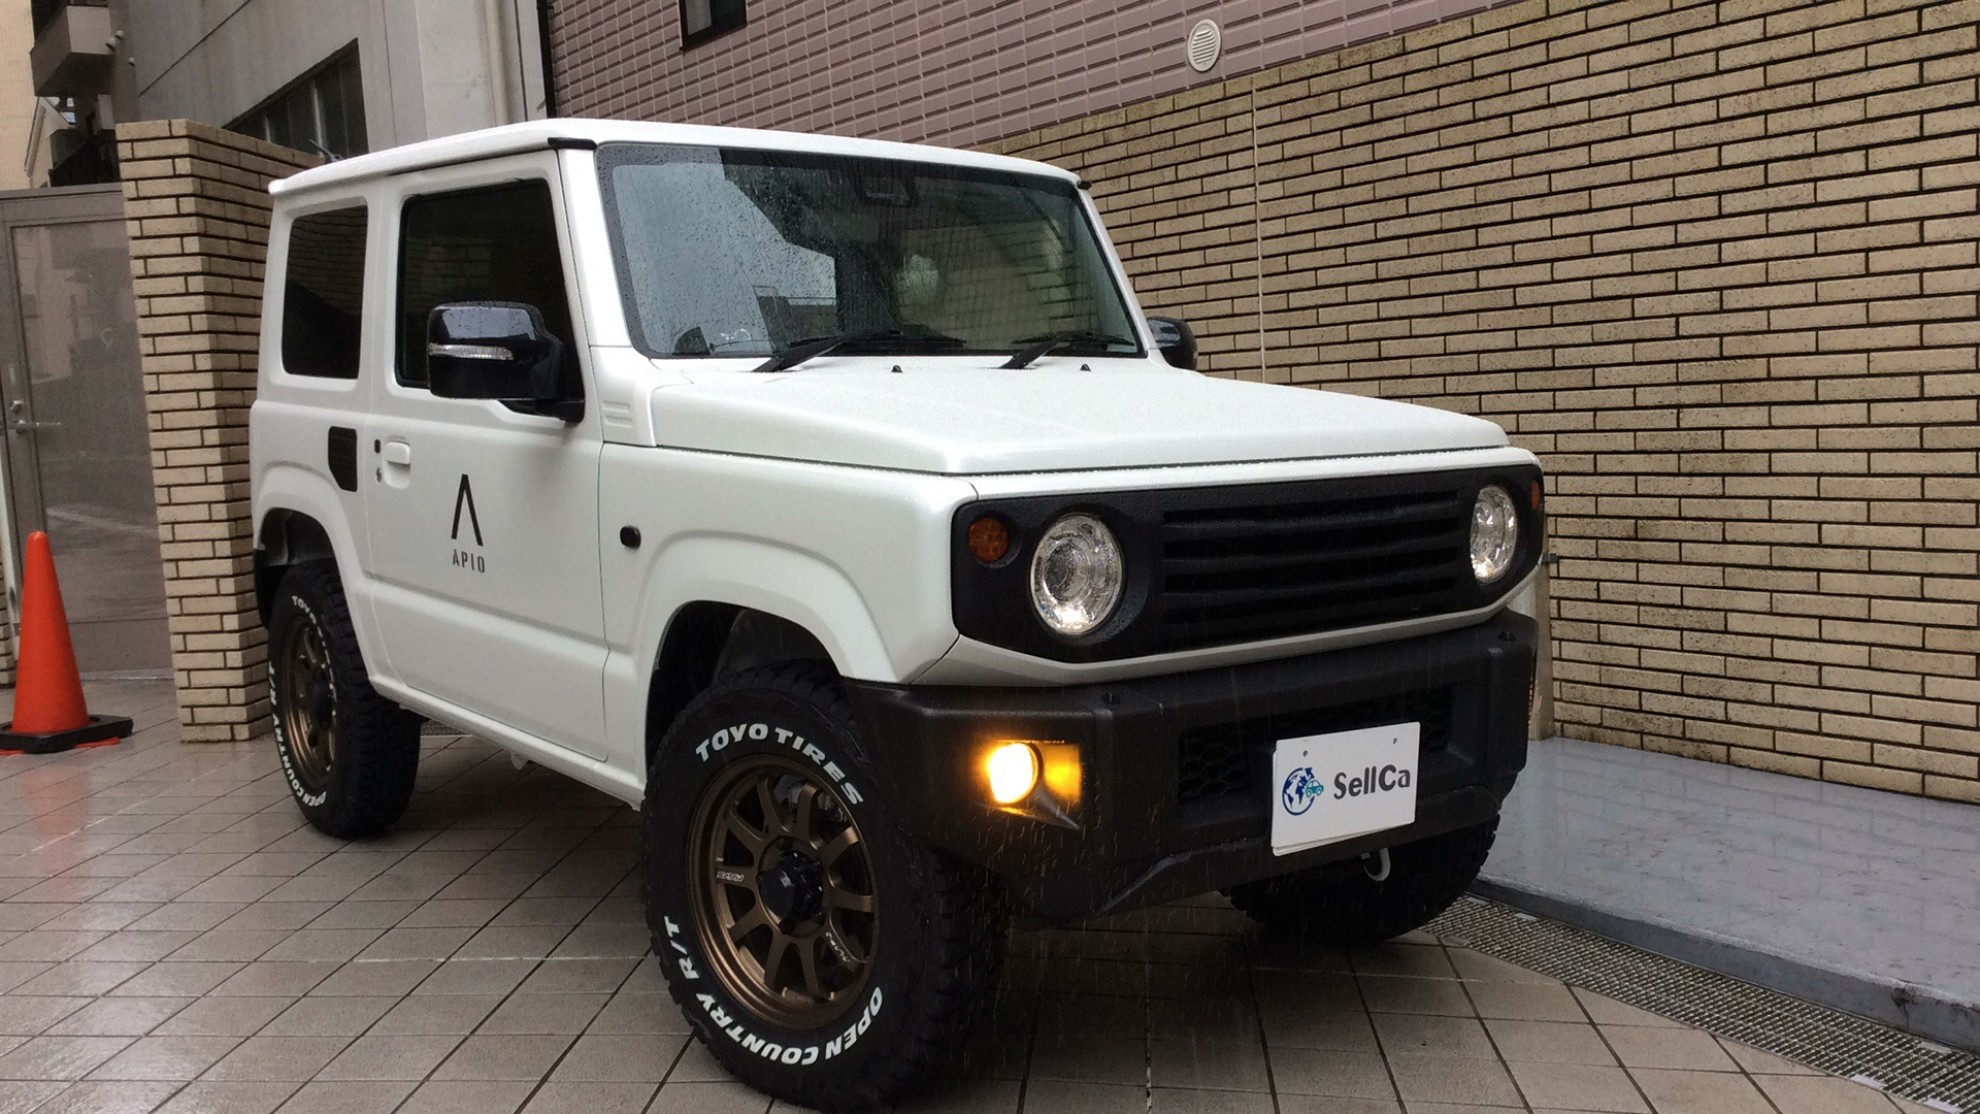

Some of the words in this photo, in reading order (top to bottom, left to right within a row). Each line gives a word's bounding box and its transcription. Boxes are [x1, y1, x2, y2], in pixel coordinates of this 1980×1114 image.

[452, 548, 486, 574] APIO
[695, 722, 769, 763] TOYO
[774, 726, 865, 805] TIRES
[1333, 764, 1412, 800] SellCa
[664, 915, 700, 981] R/T
[695, 992, 820, 1066] COUNTRY
[824, 986, 884, 1061] OPEN
